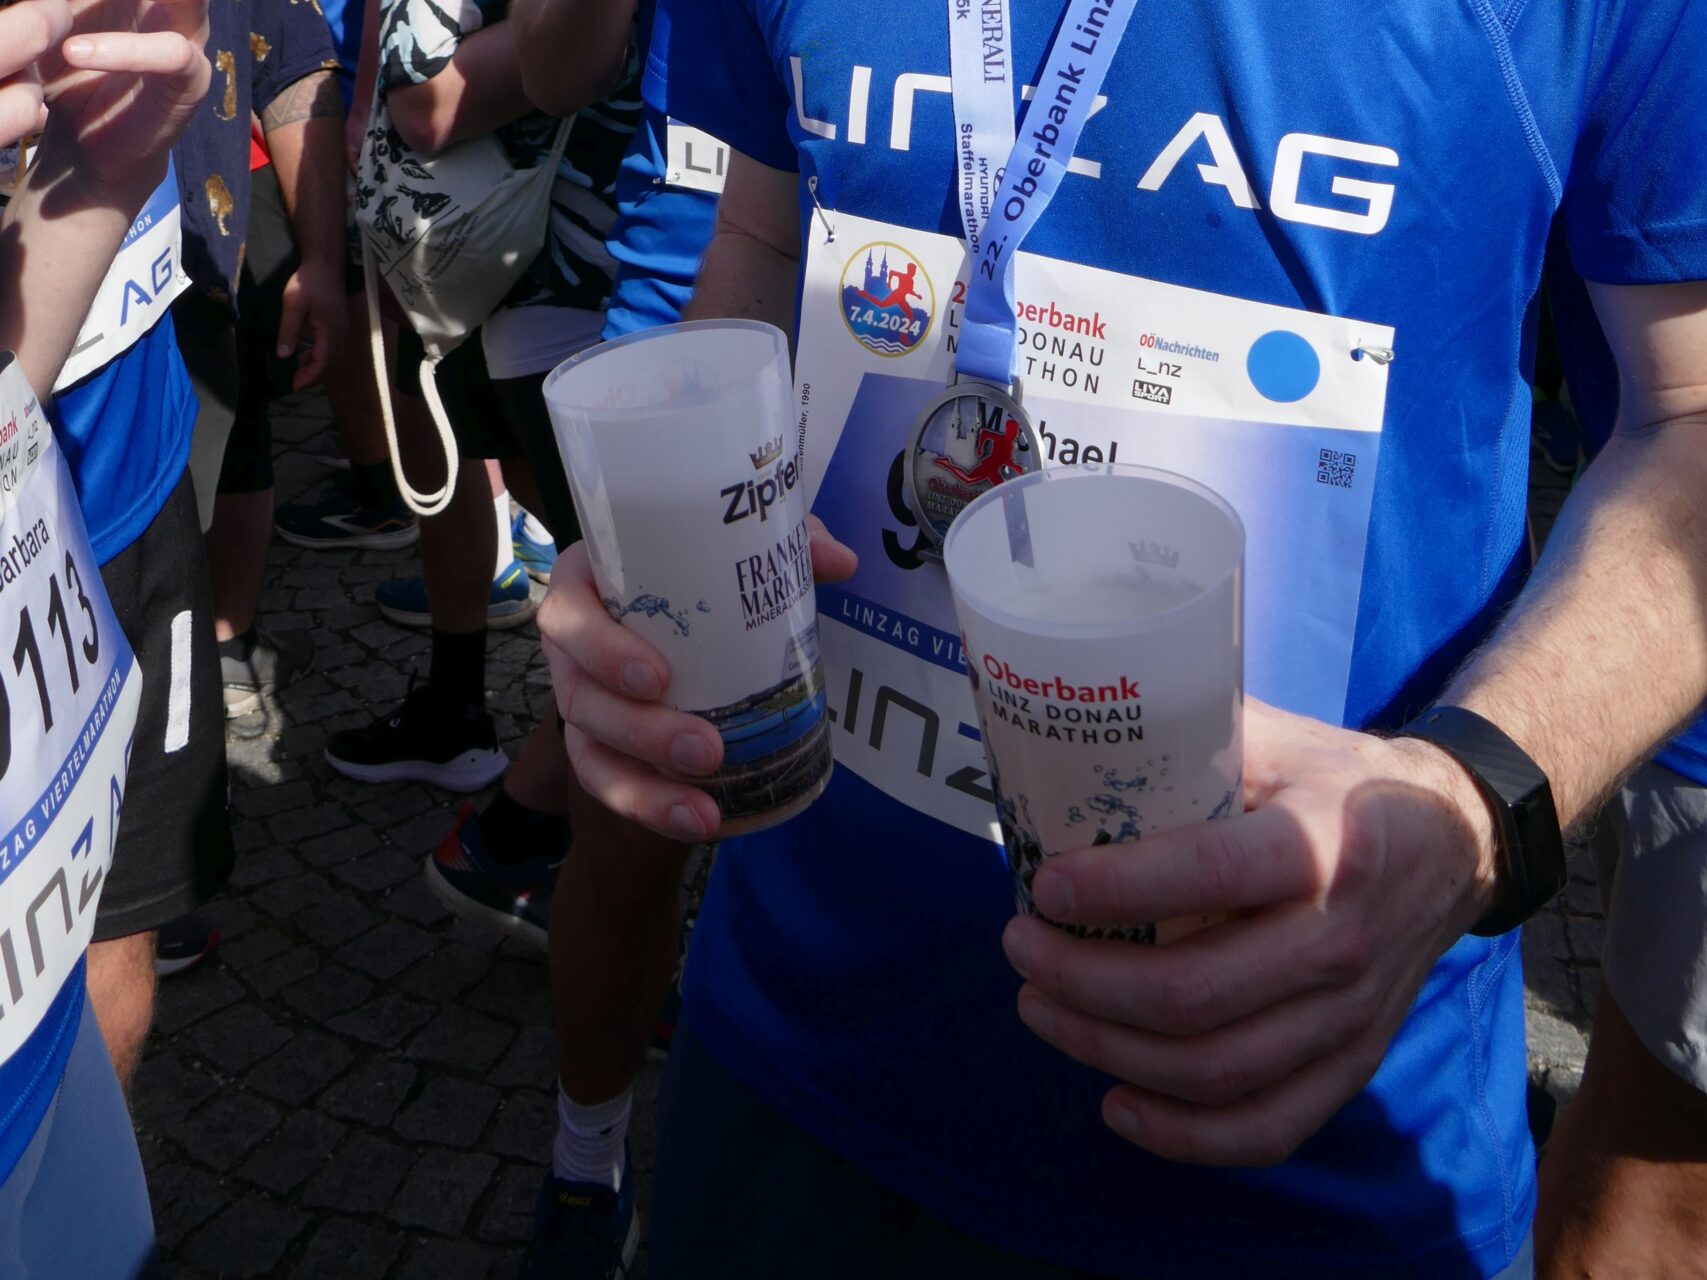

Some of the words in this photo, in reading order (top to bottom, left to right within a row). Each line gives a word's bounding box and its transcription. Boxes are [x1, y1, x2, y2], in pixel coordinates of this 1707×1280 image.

[685, 141, 724, 177] LI
[1004, 62, 1086, 222] Oberbank
[961, 123, 980, 254] Staffelmarathon
[978, 157, 990, 220] HYUNDAI
[1137, 111, 1400, 235] AG
[120, 246, 173, 328] AG
[850, 305, 921, 337] 7.4.2024
[1139, 332, 1220, 362] OÖNachrichten
[801, 383, 811, 407] 1990
[1133, 390, 1168, 403] SPORT
[1134, 381, 1169, 398] LIVA
[720, 451, 799, 525] Zipfer
[0, 517, 50, 594] arbara
[983, 653, 1142, 703] Oberbank
[987, 679, 1033, 714] LINZ
[1045, 704, 1143, 724] DONAU
[41, 668, 121, 819] VIERTELMARATHON
[991, 700, 1145, 745] MARATHON
